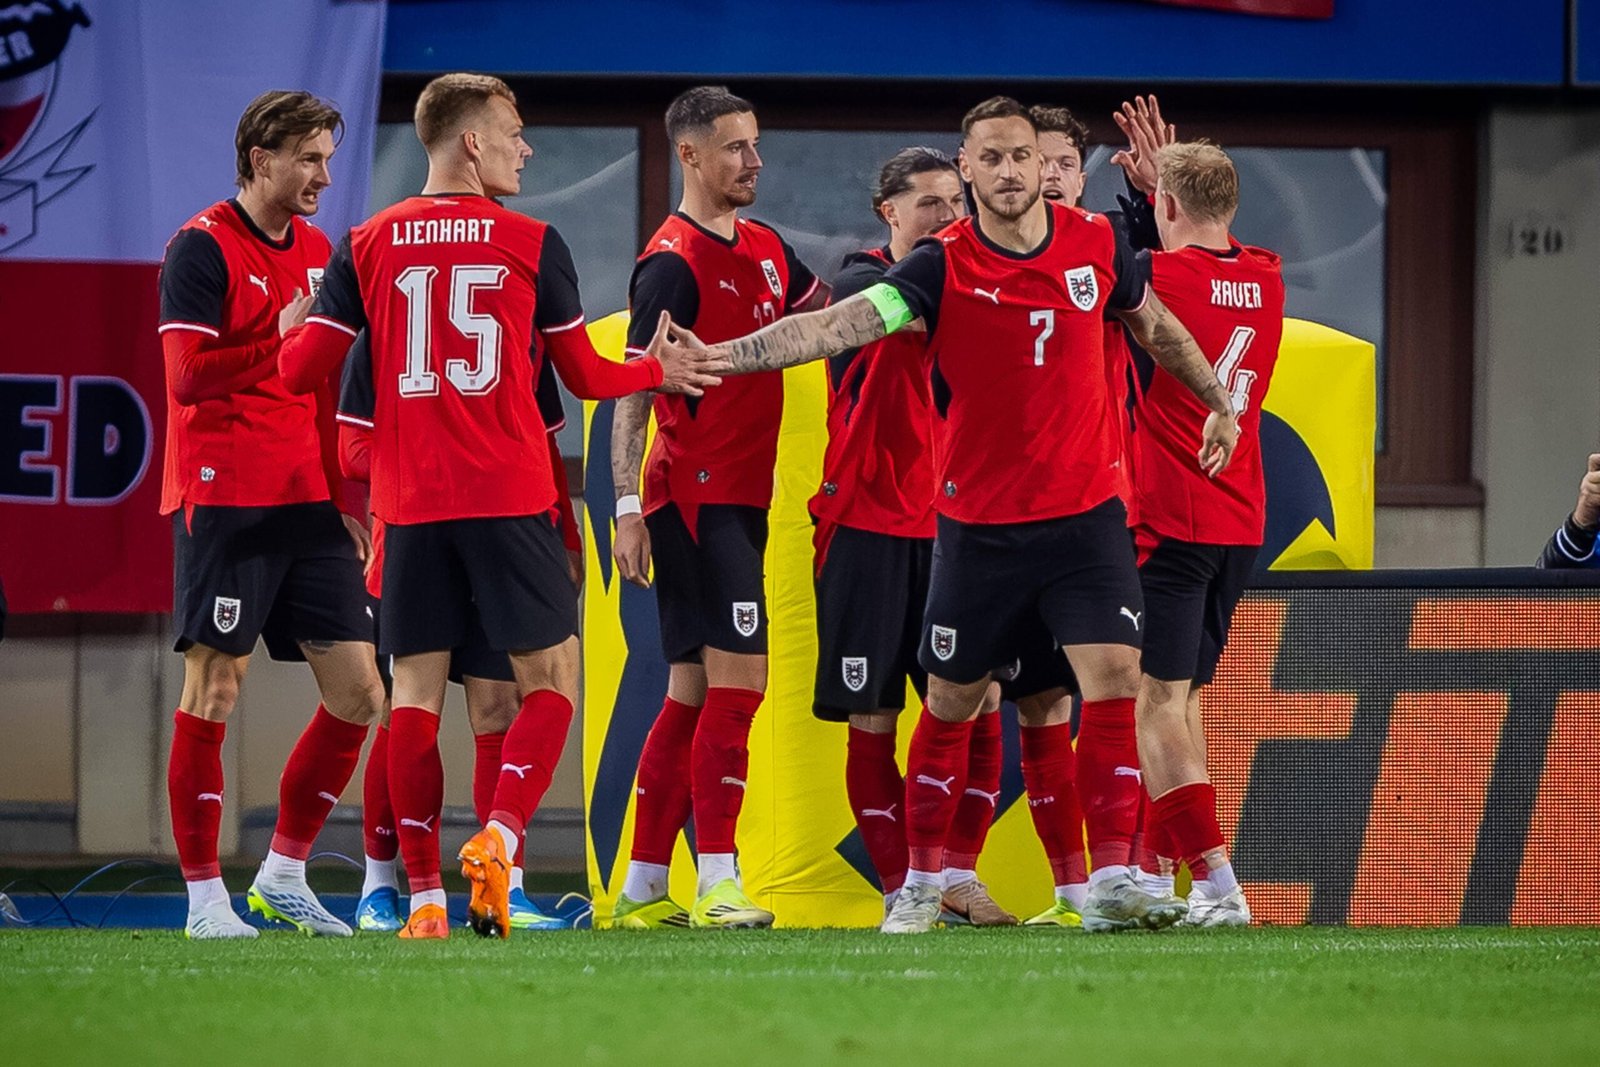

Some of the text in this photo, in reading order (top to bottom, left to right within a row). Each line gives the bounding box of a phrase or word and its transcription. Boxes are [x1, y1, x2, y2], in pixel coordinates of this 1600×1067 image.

[392, 218, 495, 246] LIENHART
[1211, 279, 1262, 308] XAVER
[395, 265, 510, 398] 15
[1029, 309, 1055, 367] 7
[0, 373, 153, 506] ED
